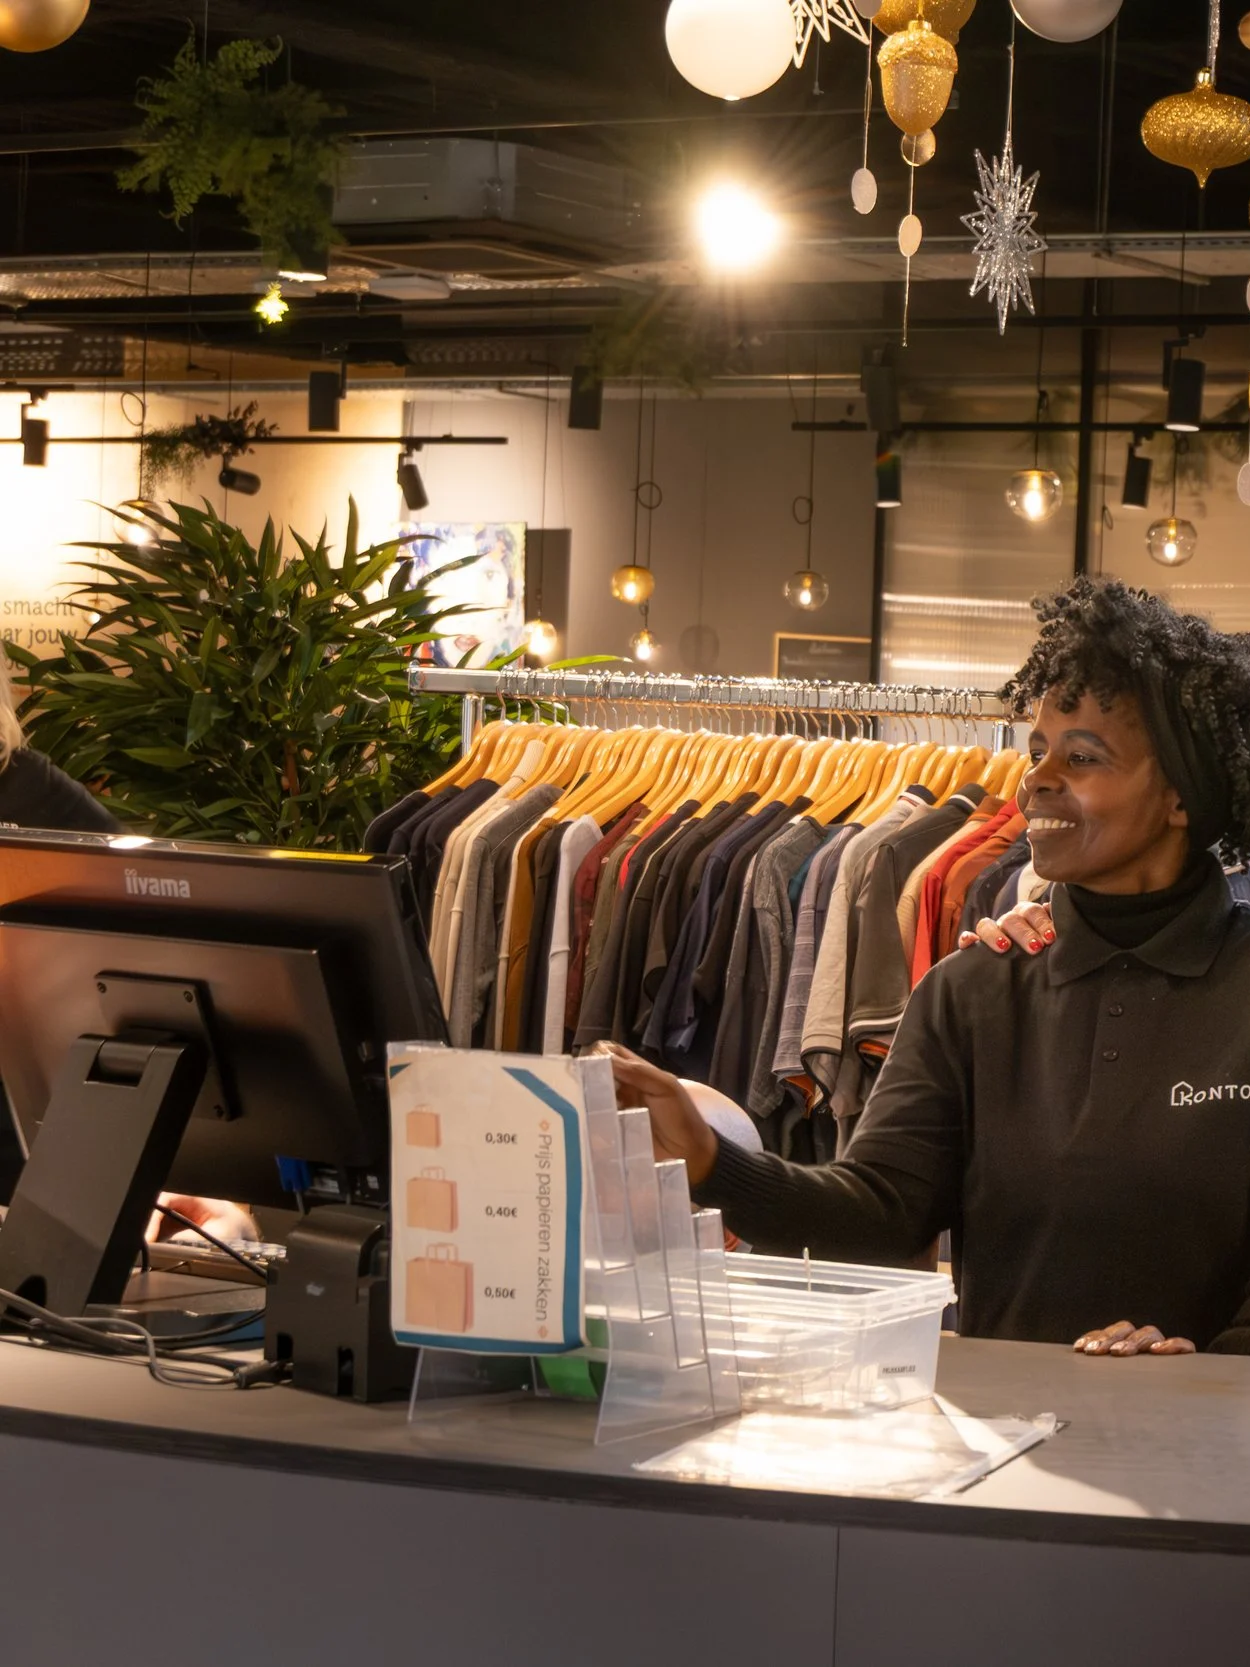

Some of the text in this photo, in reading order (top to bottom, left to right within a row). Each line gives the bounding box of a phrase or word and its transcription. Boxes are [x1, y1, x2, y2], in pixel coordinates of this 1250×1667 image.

[3, 597, 75, 616] smacht
[124, 868, 192, 898] iiyama
[485, 1132, 518, 1145] 0,30€
[485, 1205, 518, 1218] 0,40€
[535, 1133, 553, 1322] Prijs papieren zakken
[484, 1286, 517, 1299] 0,50€
